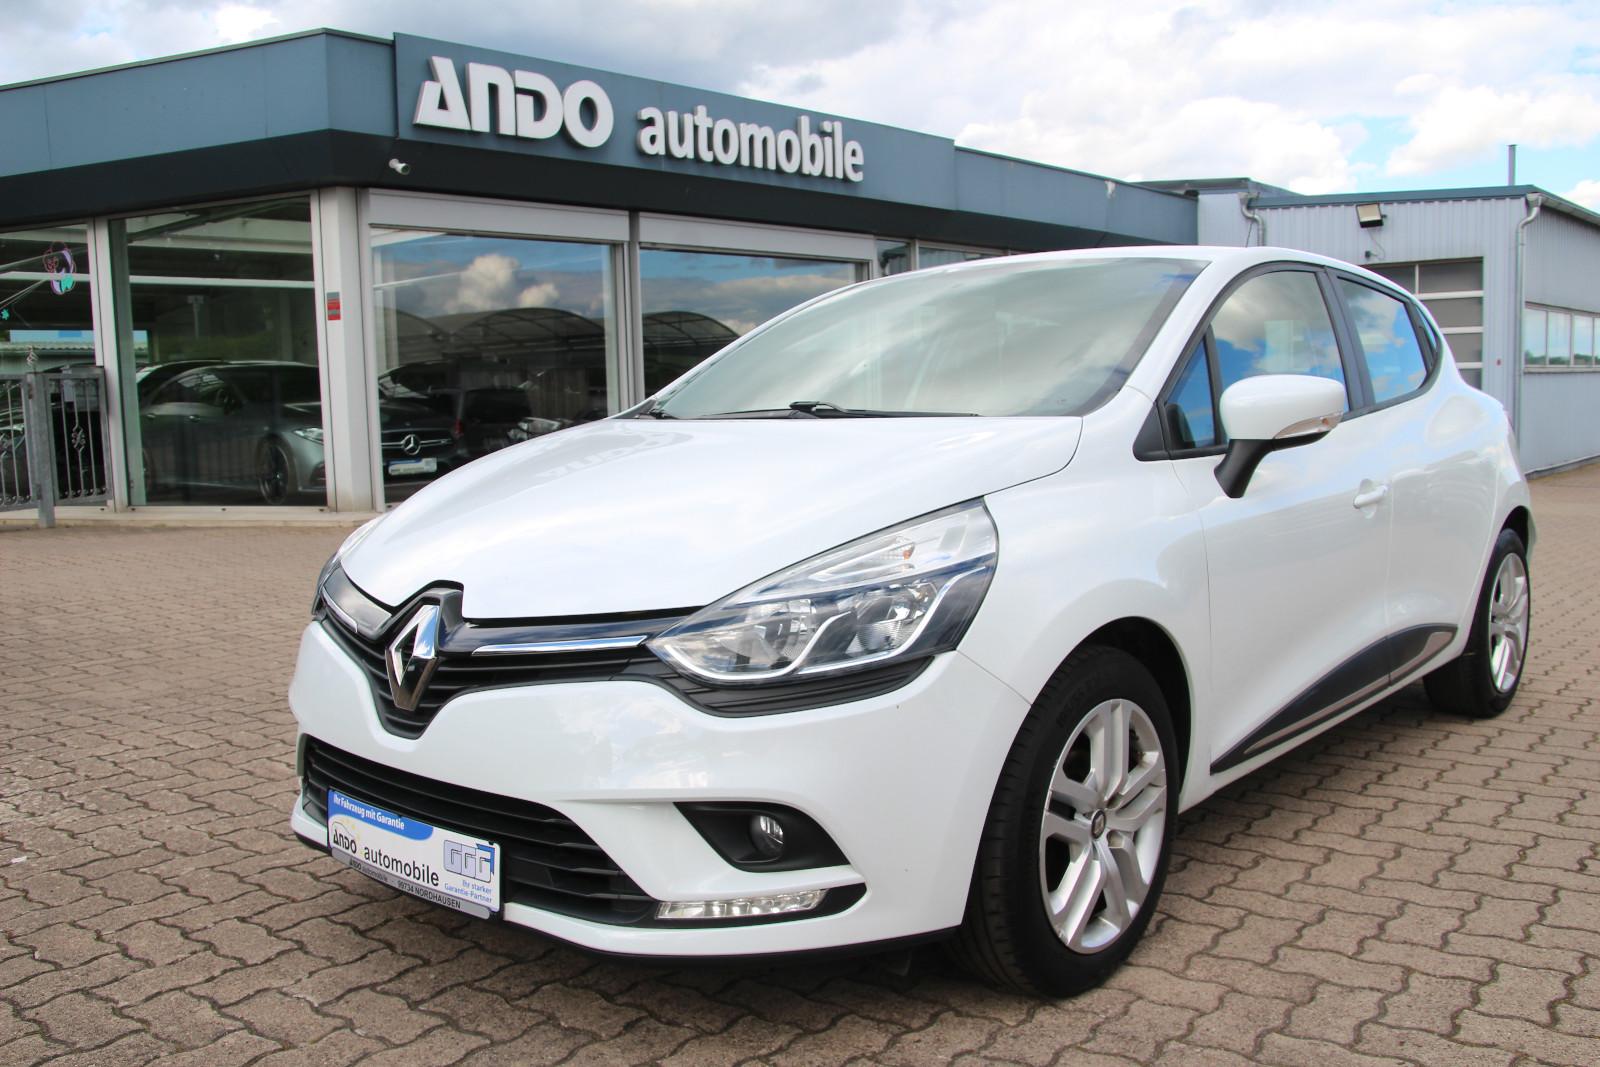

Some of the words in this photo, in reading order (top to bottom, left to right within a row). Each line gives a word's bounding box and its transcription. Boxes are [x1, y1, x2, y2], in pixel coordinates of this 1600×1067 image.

[413, 55, 614, 148] ANDO
[637, 104, 865, 183] automobile
[333, 794, 342, 806] Ihr
[341, 798, 365, 818] Fahrzeug
[365, 808, 376, 820] mit
[376, 812, 405, 830] Garantie
[364, 846, 439, 887] automobile
[397, 880, 414, 893] 99734
[414, 884, 461, 909] NORDHAUSEN
[444, 883, 492, 903] Garantie-Partner
[462, 880, 471, 889] Ihr
[471, 883, 492, 895] starker
